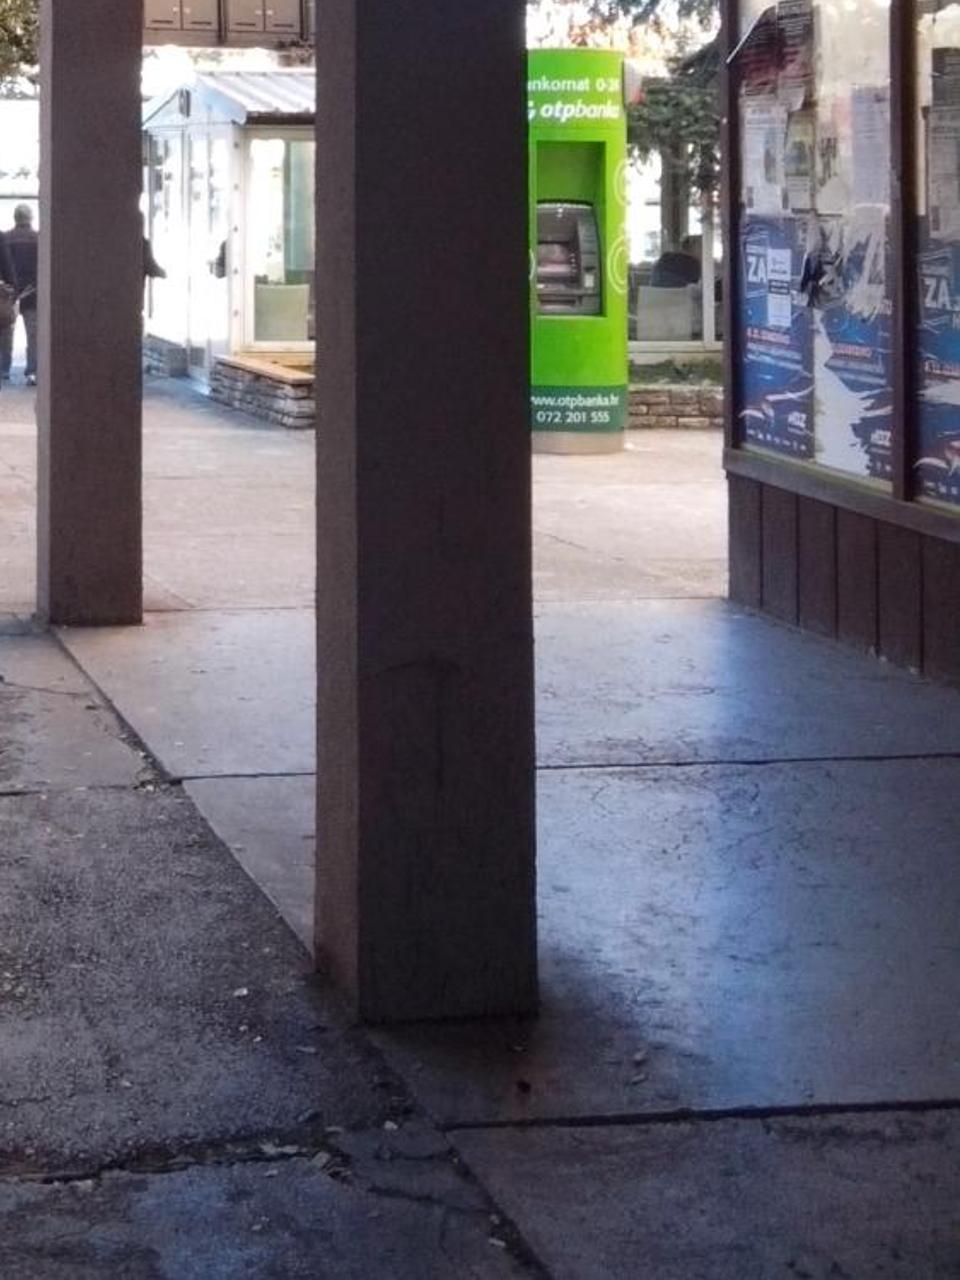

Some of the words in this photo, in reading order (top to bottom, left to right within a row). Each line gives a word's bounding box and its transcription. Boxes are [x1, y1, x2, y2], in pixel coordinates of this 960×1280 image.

[537, 411, 561, 423] 072
[565, 411, 586, 423] 201
[590, 411, 610, 423] 555
